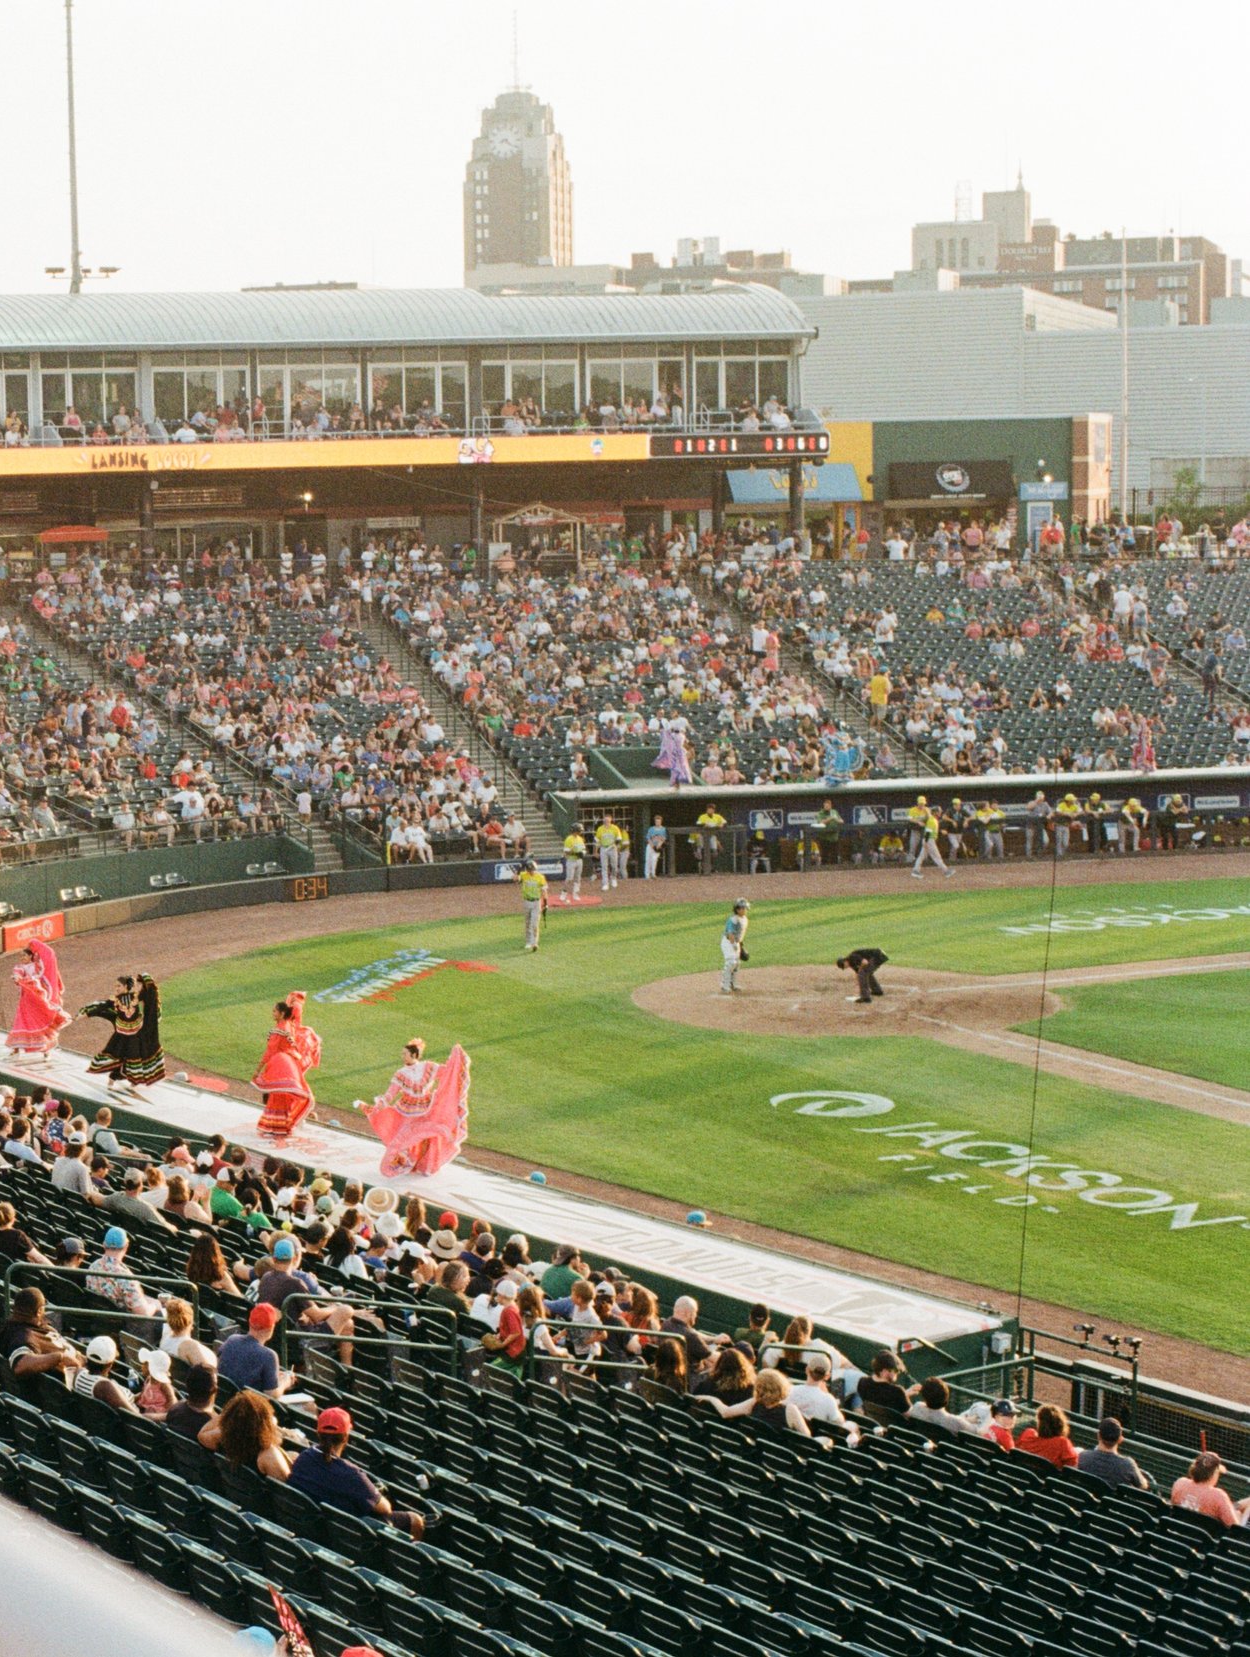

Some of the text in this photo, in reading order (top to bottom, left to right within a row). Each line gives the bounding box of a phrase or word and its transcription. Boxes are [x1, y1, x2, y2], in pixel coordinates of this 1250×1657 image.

[91, 451, 149, 470] LANSING
[295, 876, 328, 900] 0:34
[852, 1121, 1245, 1231] JACKSON
[878, 1153, 1040, 1208] FIELD
